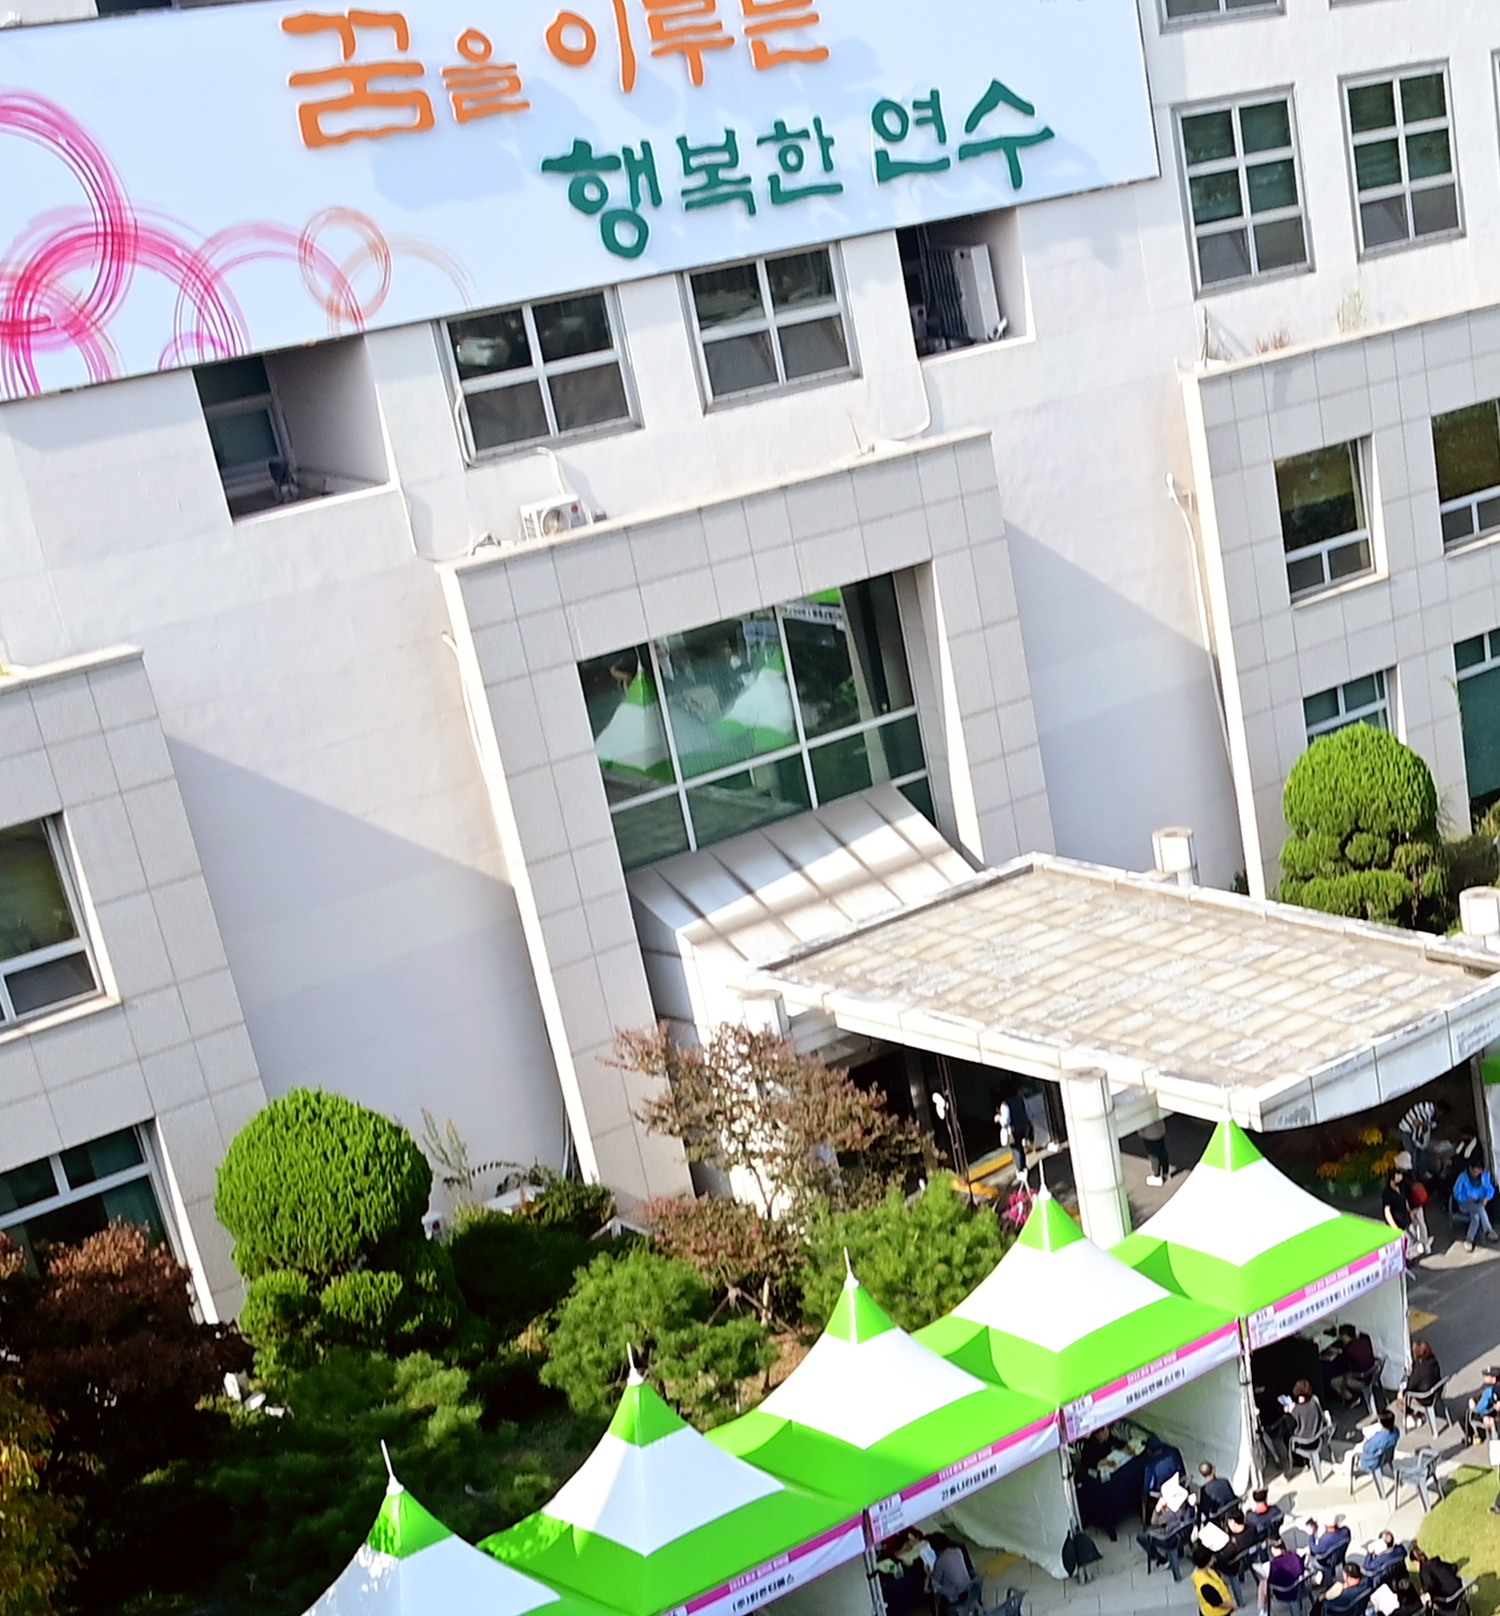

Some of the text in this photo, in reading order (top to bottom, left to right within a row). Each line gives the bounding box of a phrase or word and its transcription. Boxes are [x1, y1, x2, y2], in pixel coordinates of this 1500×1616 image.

[281, 10, 531, 148] 꿈을
[541, 78, 1056, 260] 행복한 연수
